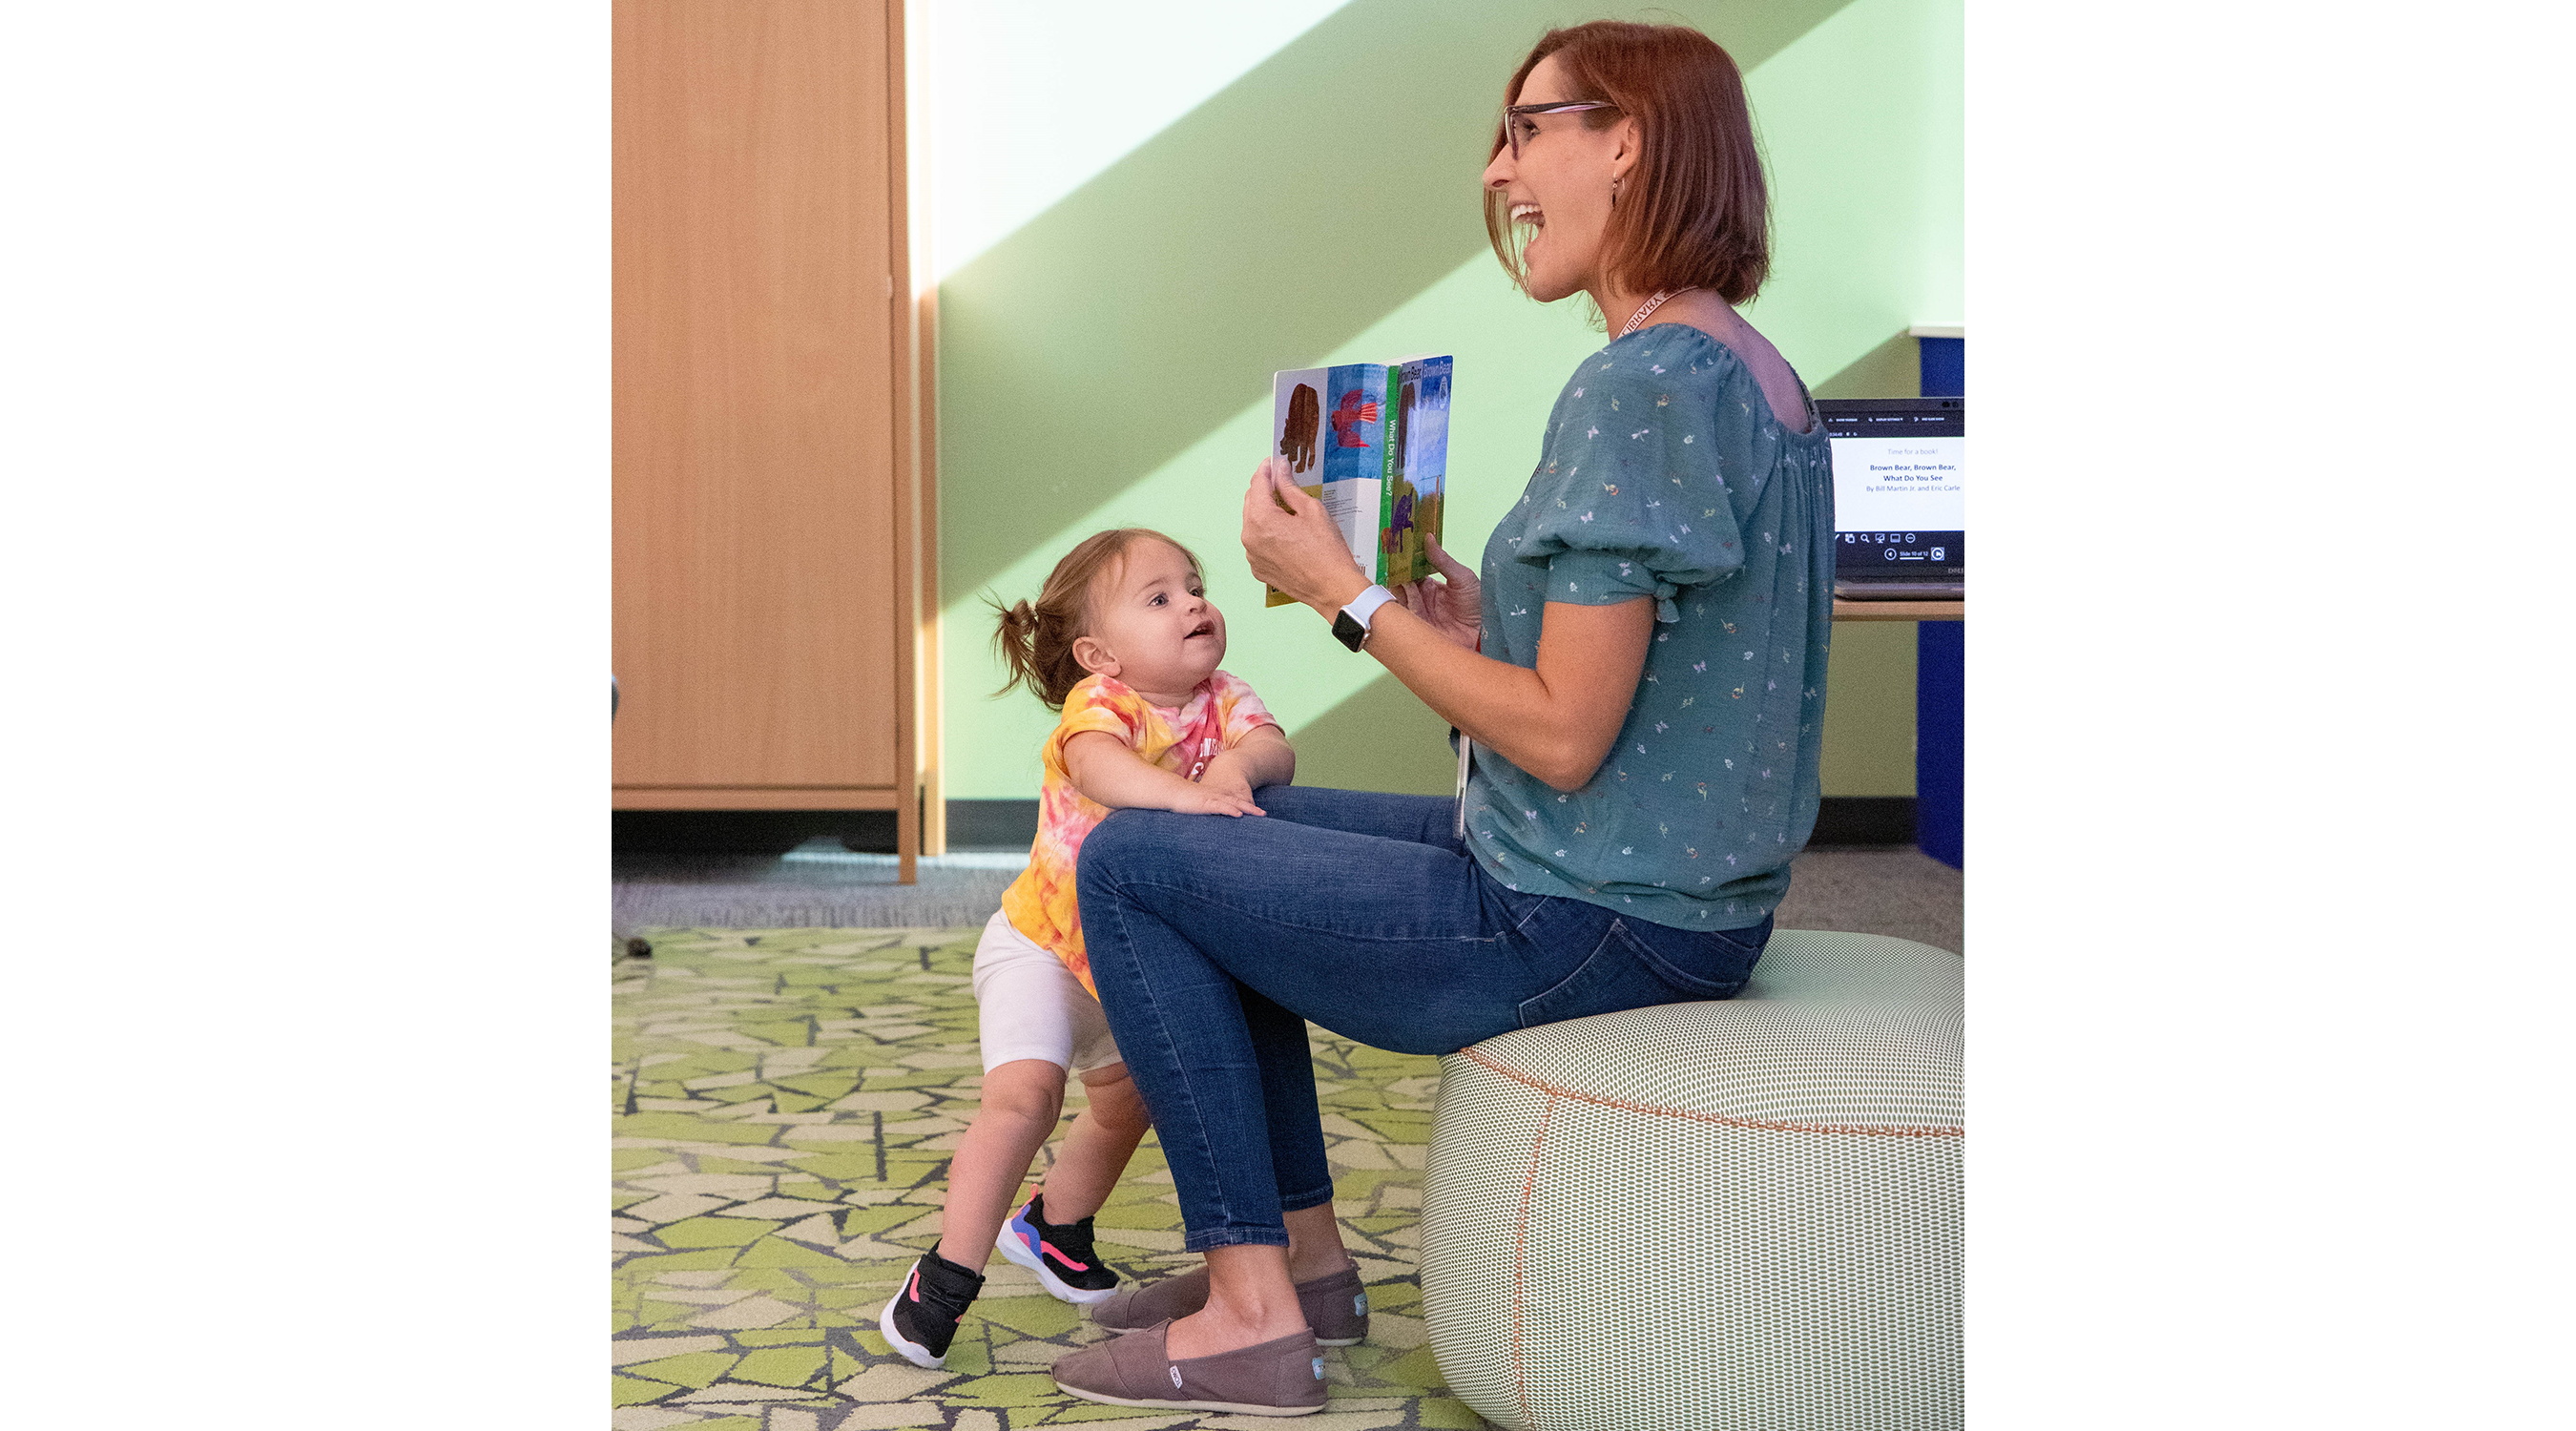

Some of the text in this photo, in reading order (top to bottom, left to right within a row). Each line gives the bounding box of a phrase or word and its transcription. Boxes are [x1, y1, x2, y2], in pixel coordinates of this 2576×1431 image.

[1385, 419, 1397, 496] What Do You See?
[1171, 1368, 1181, 1386] TOMS
